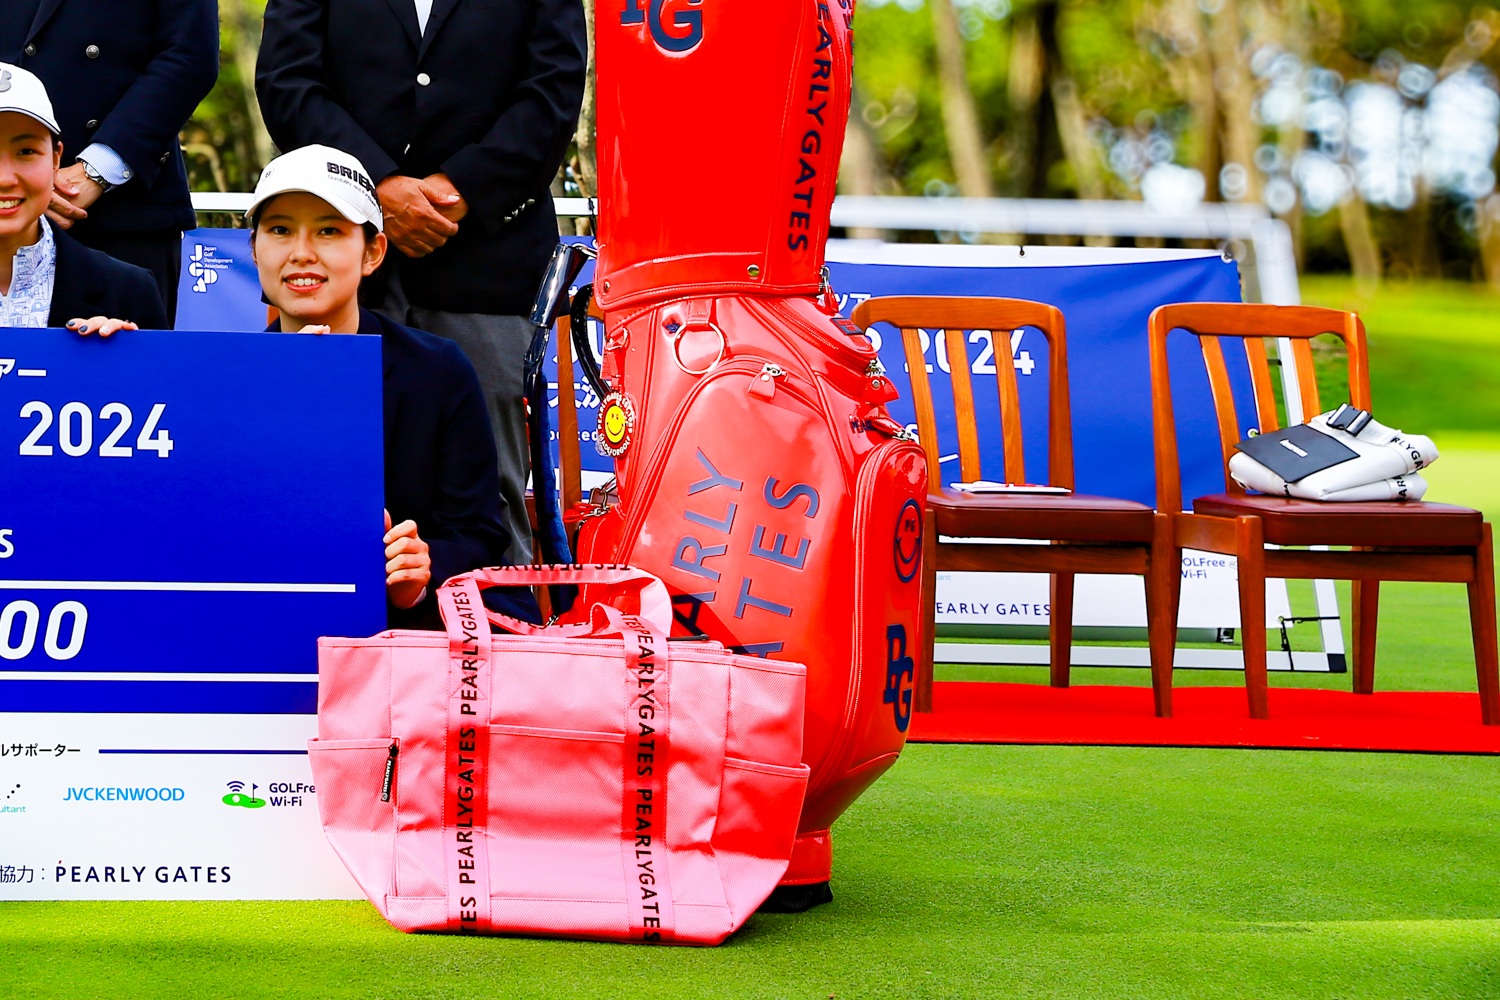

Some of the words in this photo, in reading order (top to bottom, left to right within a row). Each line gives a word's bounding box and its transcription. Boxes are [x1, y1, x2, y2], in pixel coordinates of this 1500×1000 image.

[18, 400, 174, 459] 2024
[671, 446, 744, 636] ARLY
[1182, 557, 1226, 568] OLFree
[936, 602, 989, 615] EARLY
[996, 603, 1051, 616] GATES
[453, 592, 479, 715] PEARLYGATES
[637, 626, 657, 777] PEARLYGATES
[63, 786, 185, 802] JVCKENWOOD
[268, 782, 316, 795] GOLFre
[270, 795, 303, 808] Wi-Fi
[456, 727, 477, 885] PEARLYGATES
[56, 863, 146, 884] PEARLY
[155, 865, 232, 884] GATES
[635, 788, 661, 942] PEARLYGATES
